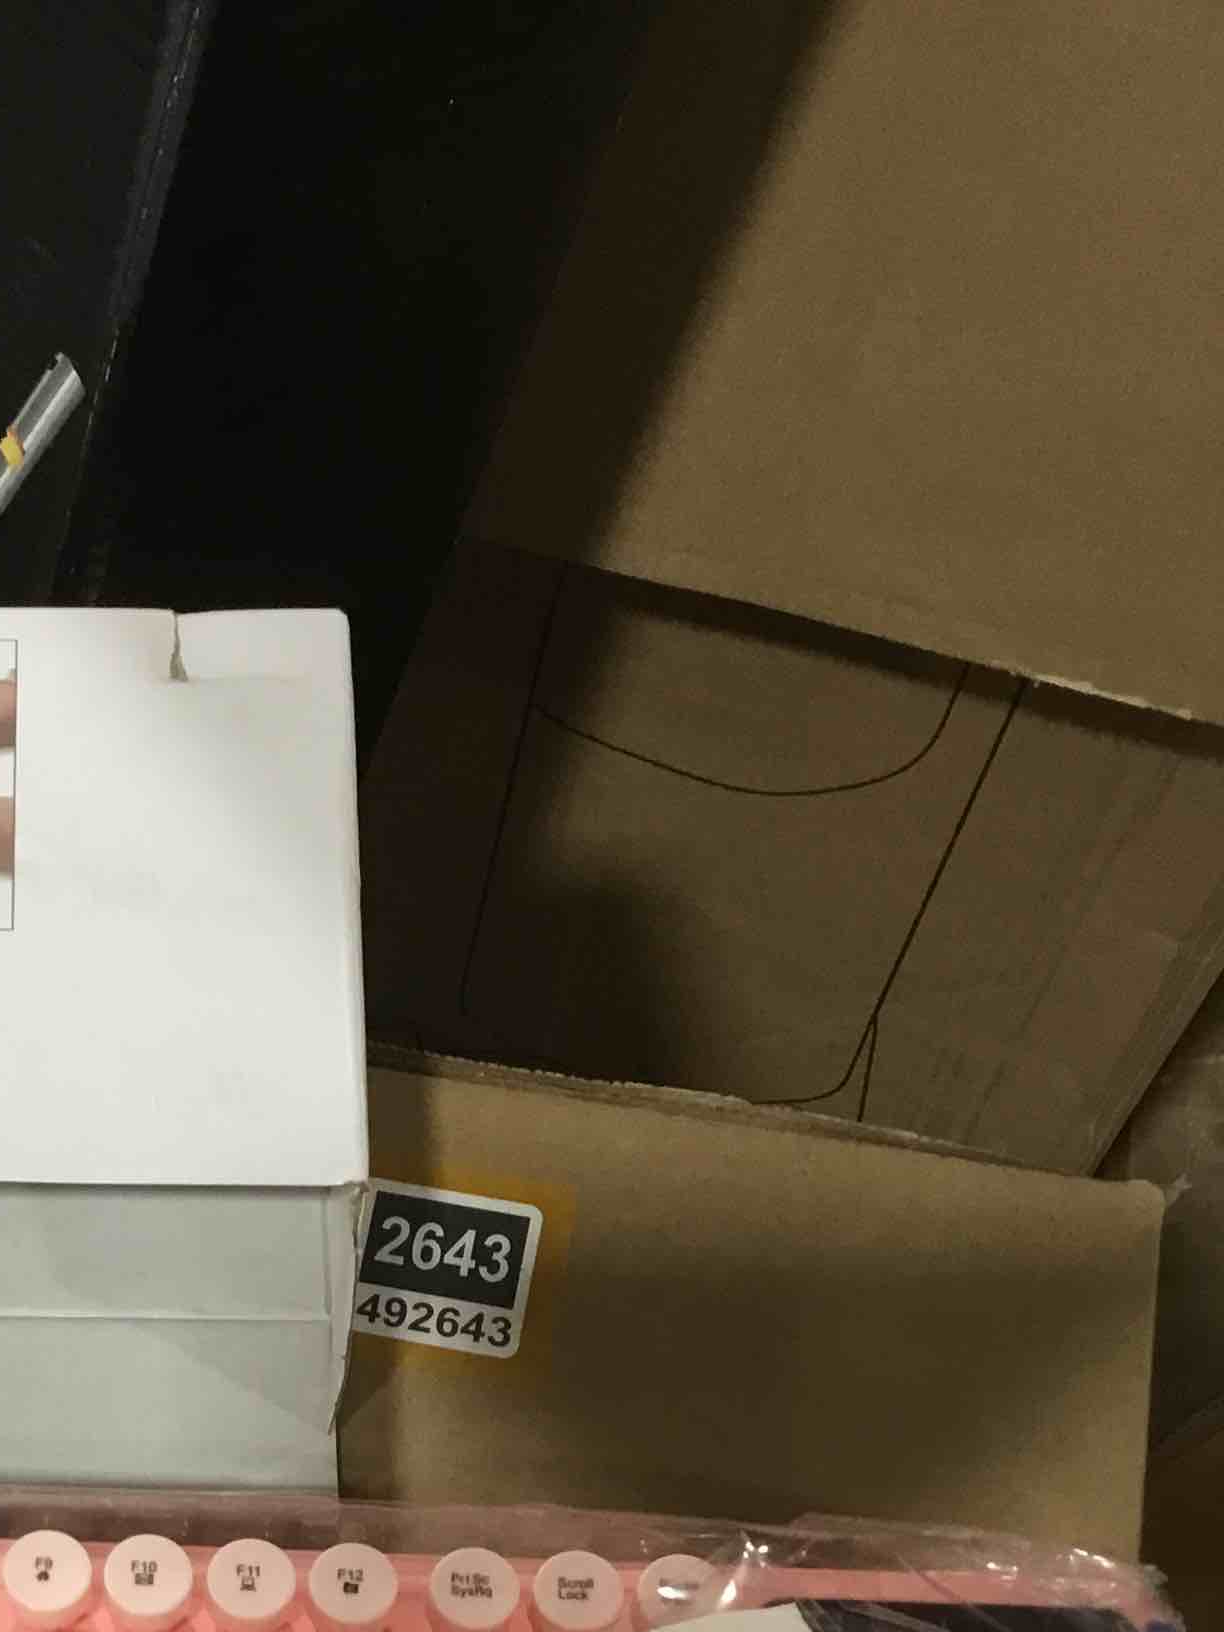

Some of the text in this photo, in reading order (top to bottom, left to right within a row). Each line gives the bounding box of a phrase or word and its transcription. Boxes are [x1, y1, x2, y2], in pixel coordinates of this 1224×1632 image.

[375, 1216, 512, 1283] 2643
[356, 1293, 512, 1347] 492643
[35, 1557, 53, 1570] F9
[131, 1560, 157, 1574] F10
[236, 1564, 260, 1578] F11
[337, 1569, 363, 1582] F12
